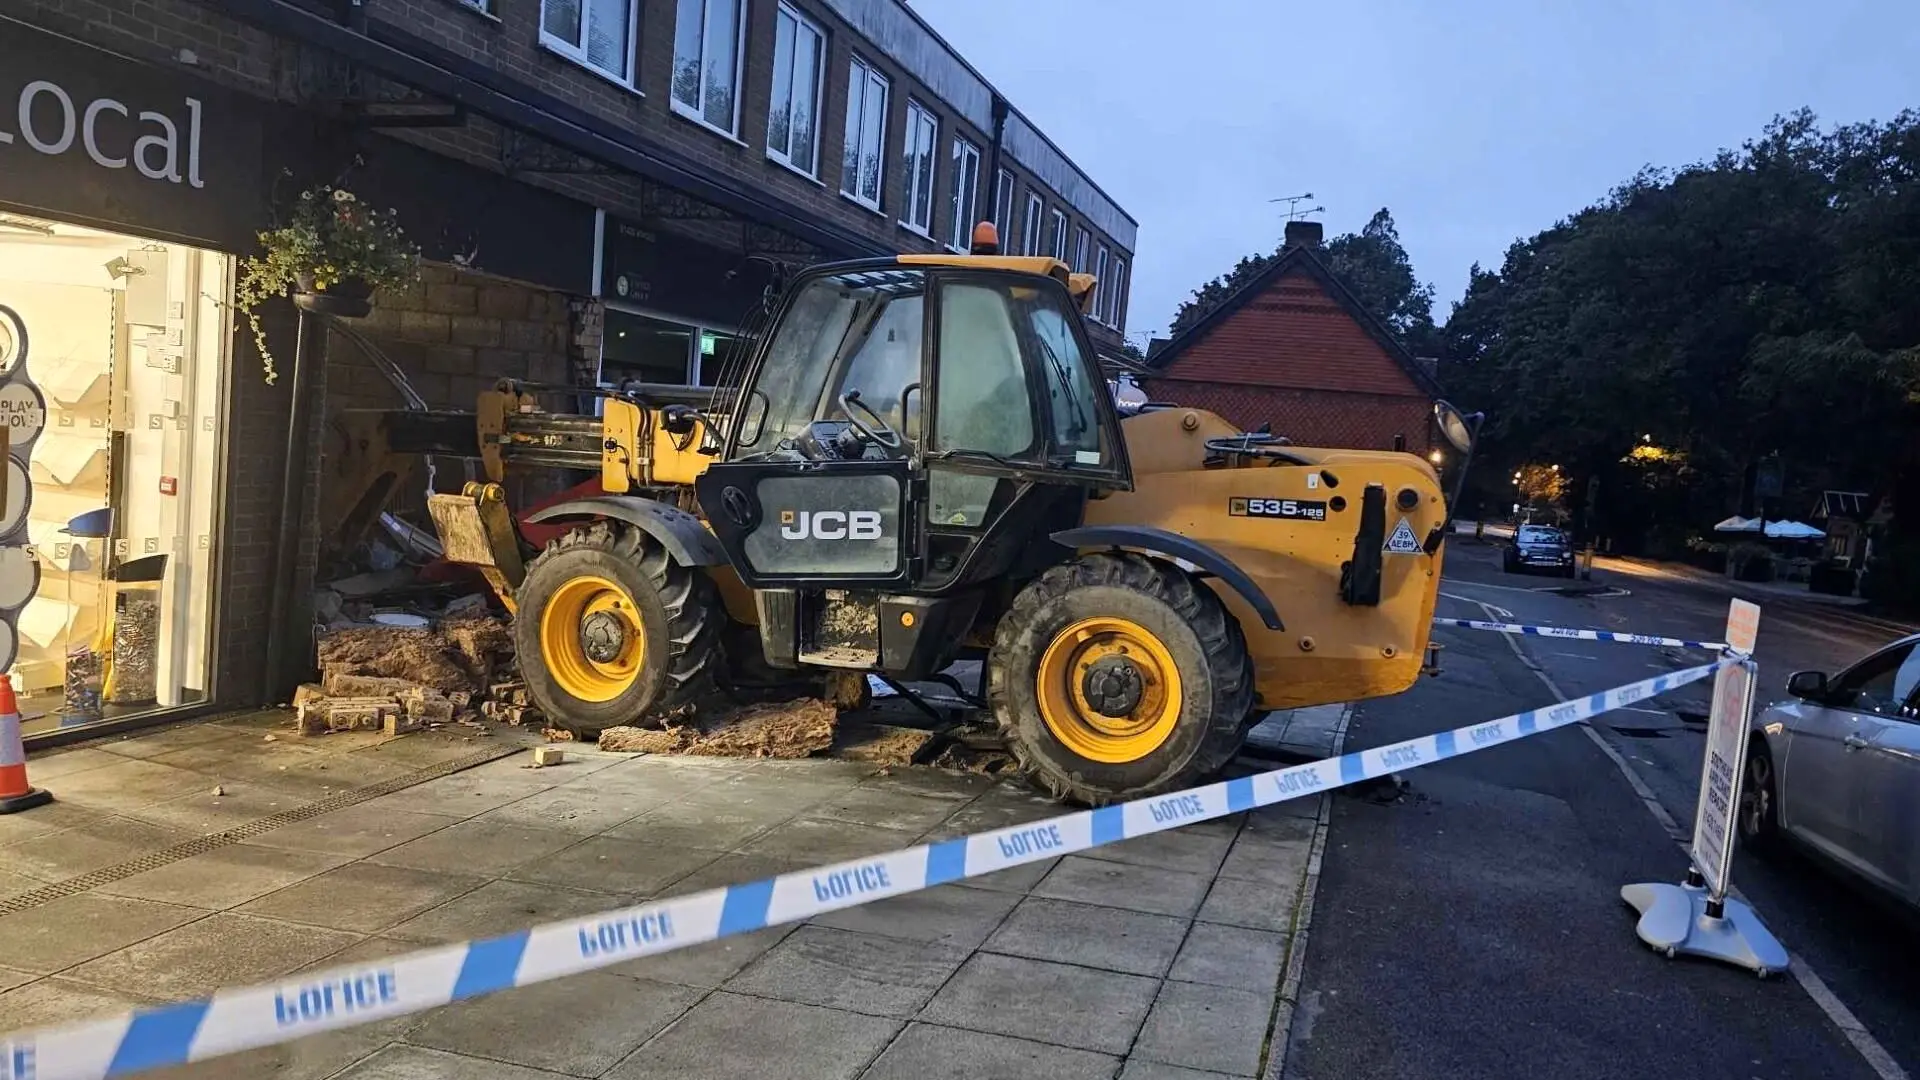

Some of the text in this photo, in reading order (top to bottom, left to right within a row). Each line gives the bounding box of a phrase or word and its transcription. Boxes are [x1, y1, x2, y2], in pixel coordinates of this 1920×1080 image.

[0, 80, 204, 188] ocal
[1248, 499, 1324, 517] 535-125
[781, 511, 882, 540] JCB
[1397, 531, 1409, 539] 39
